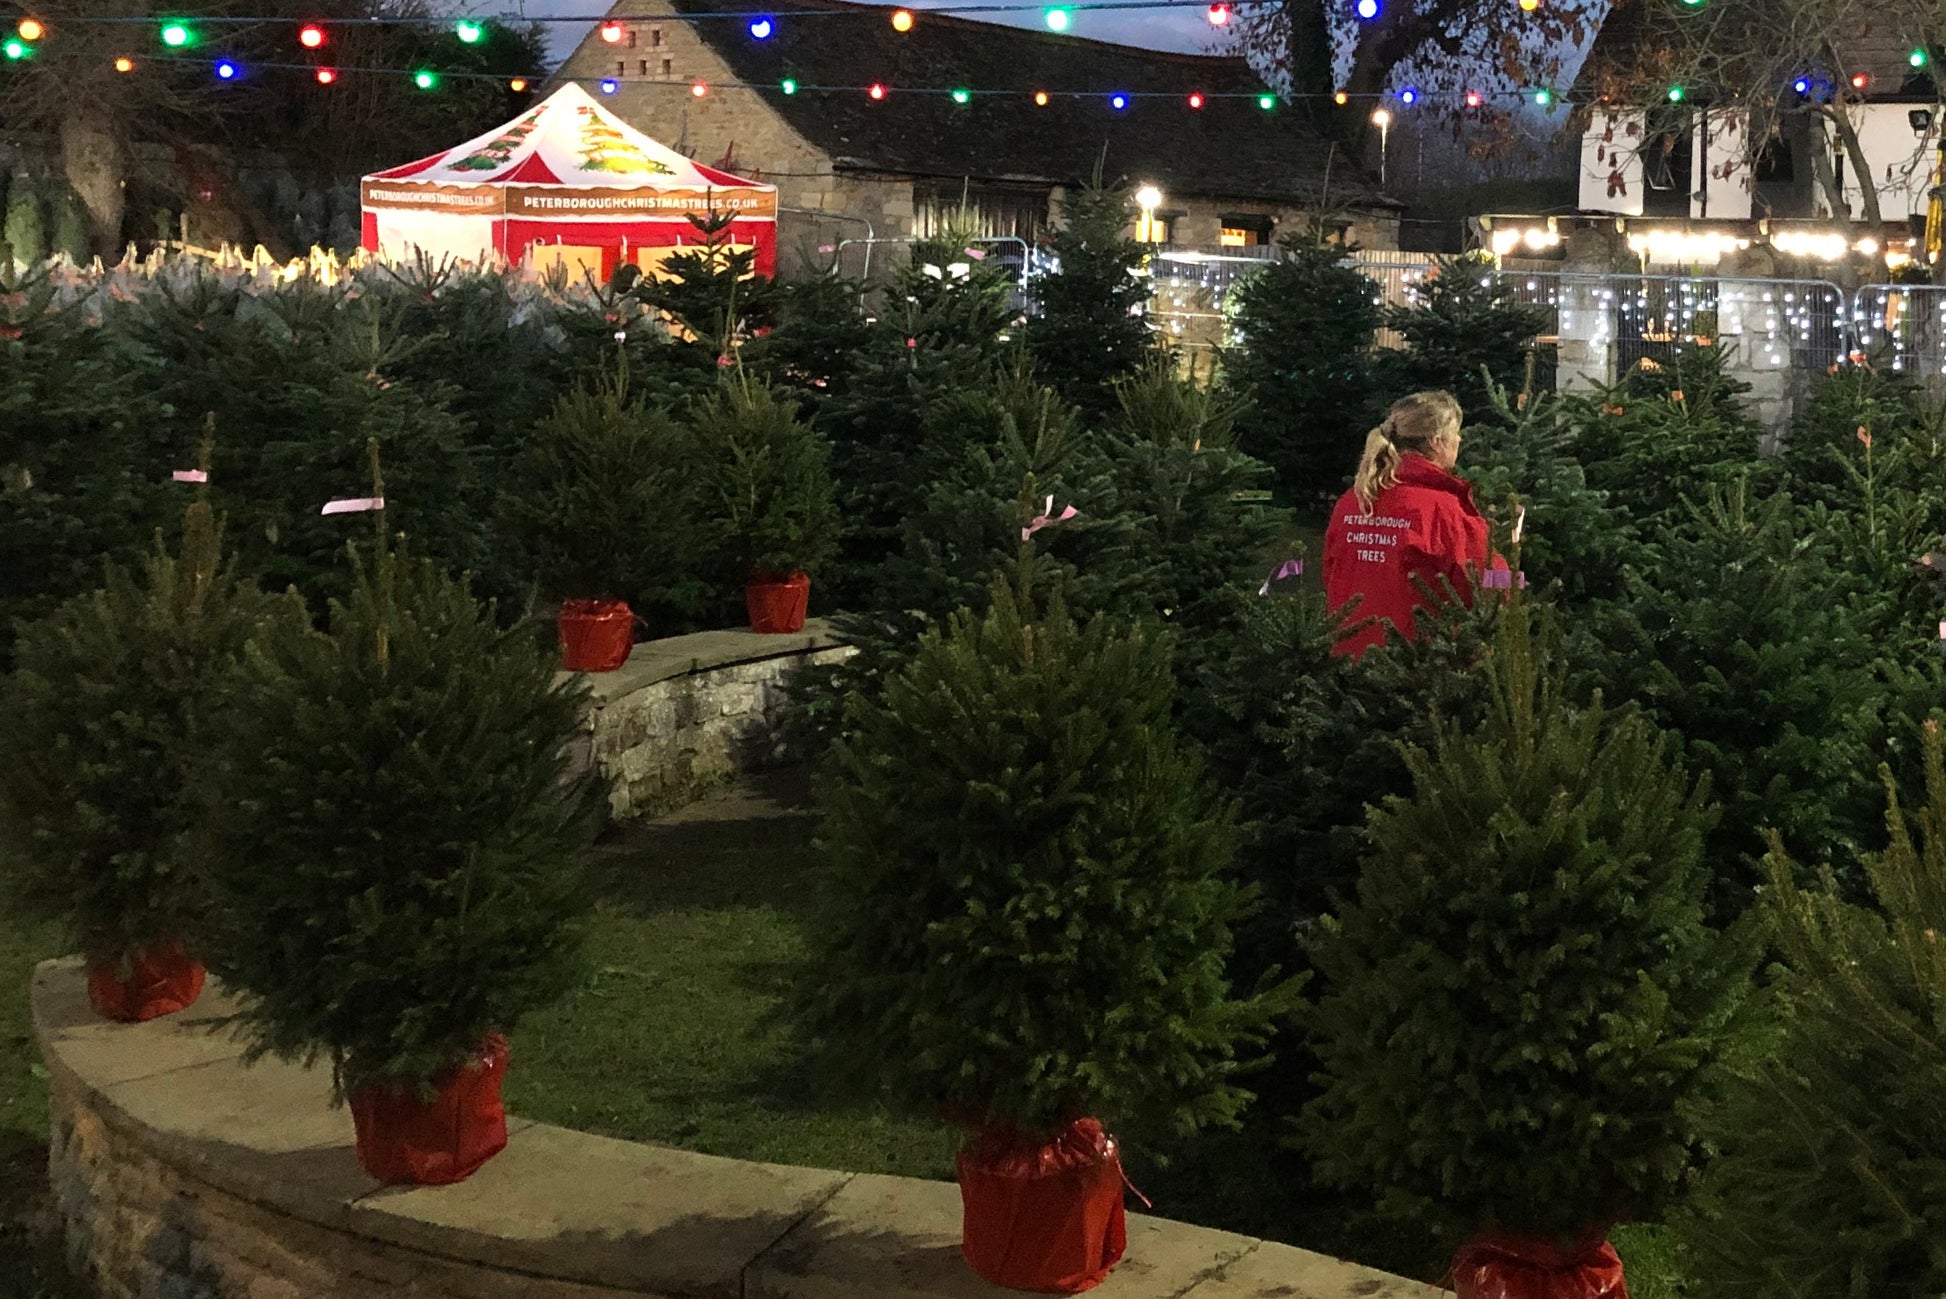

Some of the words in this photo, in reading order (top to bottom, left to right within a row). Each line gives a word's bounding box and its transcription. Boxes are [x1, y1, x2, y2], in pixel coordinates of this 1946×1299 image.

[1343, 515, 1411, 529] PETERBOROUGH
[1346, 532, 1398, 546] CHRISTMAS
[1357, 549, 1386, 563] TREES
